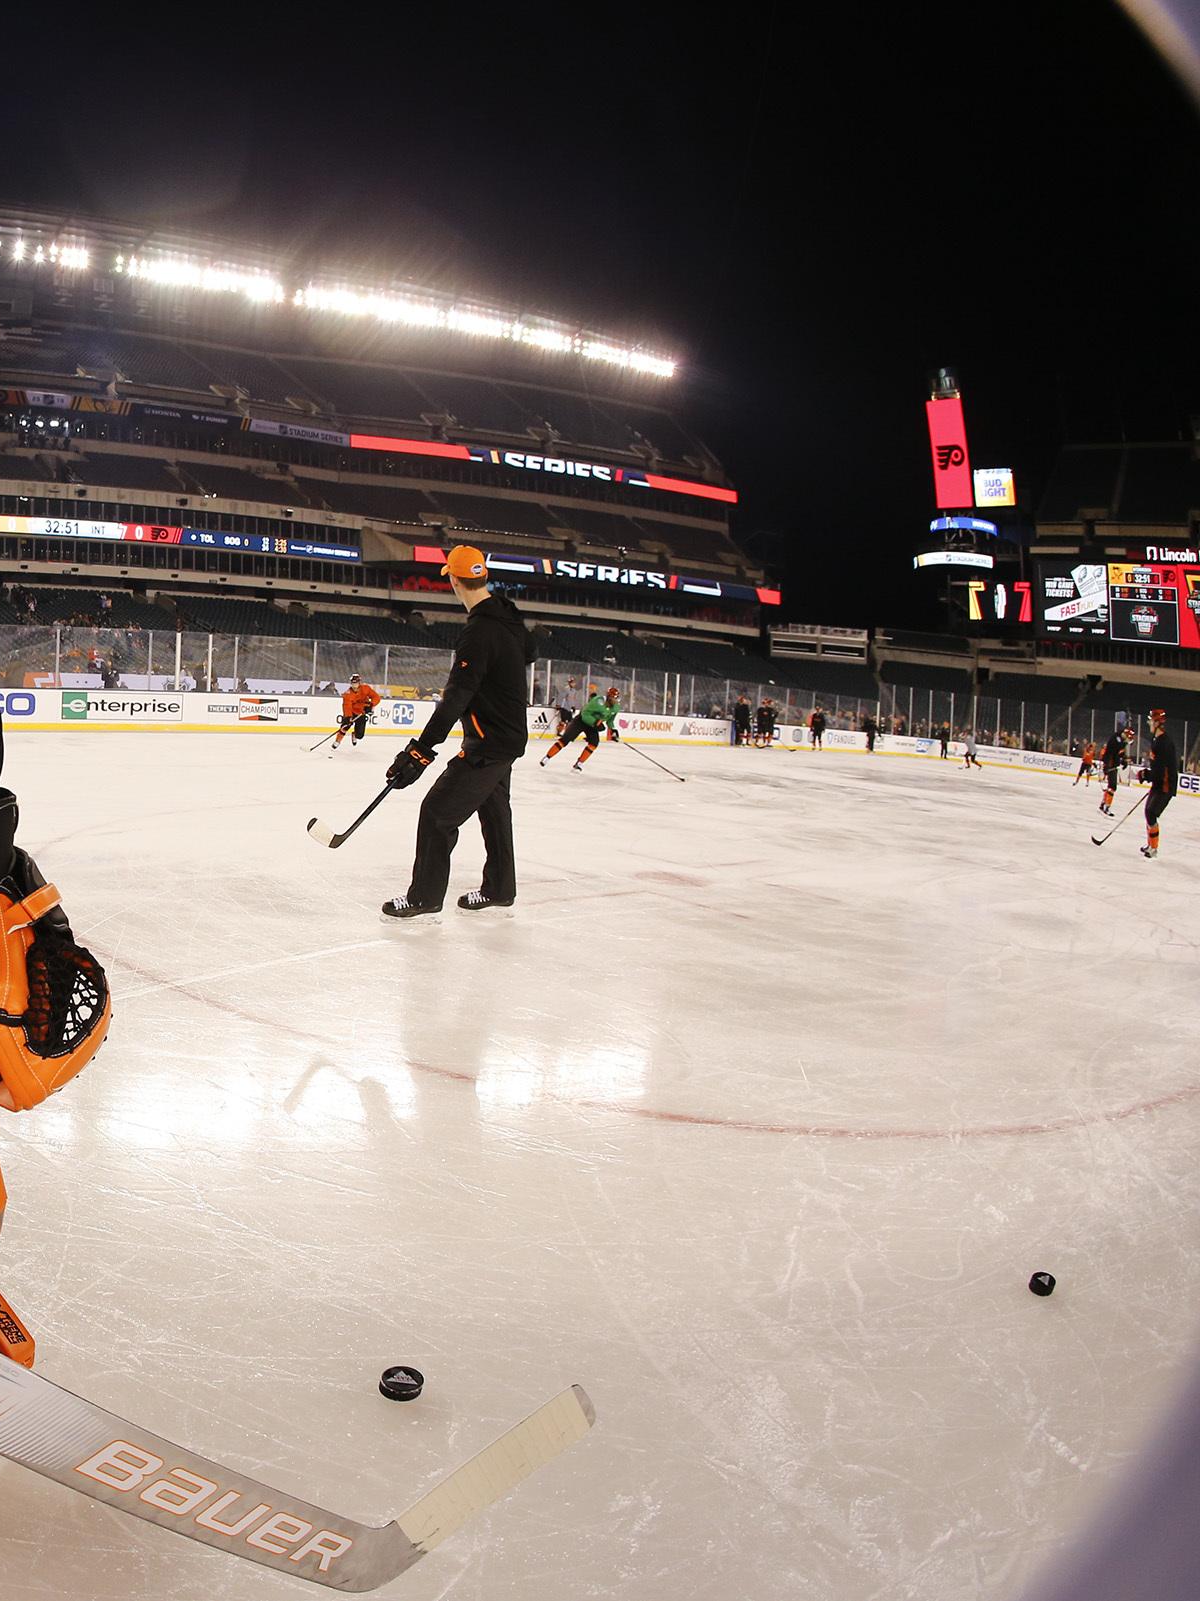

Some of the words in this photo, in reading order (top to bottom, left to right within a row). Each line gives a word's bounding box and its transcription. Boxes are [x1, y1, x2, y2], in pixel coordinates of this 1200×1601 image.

[289, 428, 321, 440] STADIUM
[321, 432, 344, 443] SERIES
[45, 520, 79, 535] 32:51
[92, 525, 106, 535] INT
[135, 527, 144, 540] 0
[1159, 547, 1197, 562] Lincoln
[67, 698, 181, 716] enterprise
[241, 705, 277, 714] CHAMPION
[380, 708, 390, 718] by
[393, 705, 413, 724] PPG
[640, 720, 673, 732] DUNKIN'
[1023, 755, 1072, 770] ticketmaster
[75, 1439, 353, 1573] BAUER
